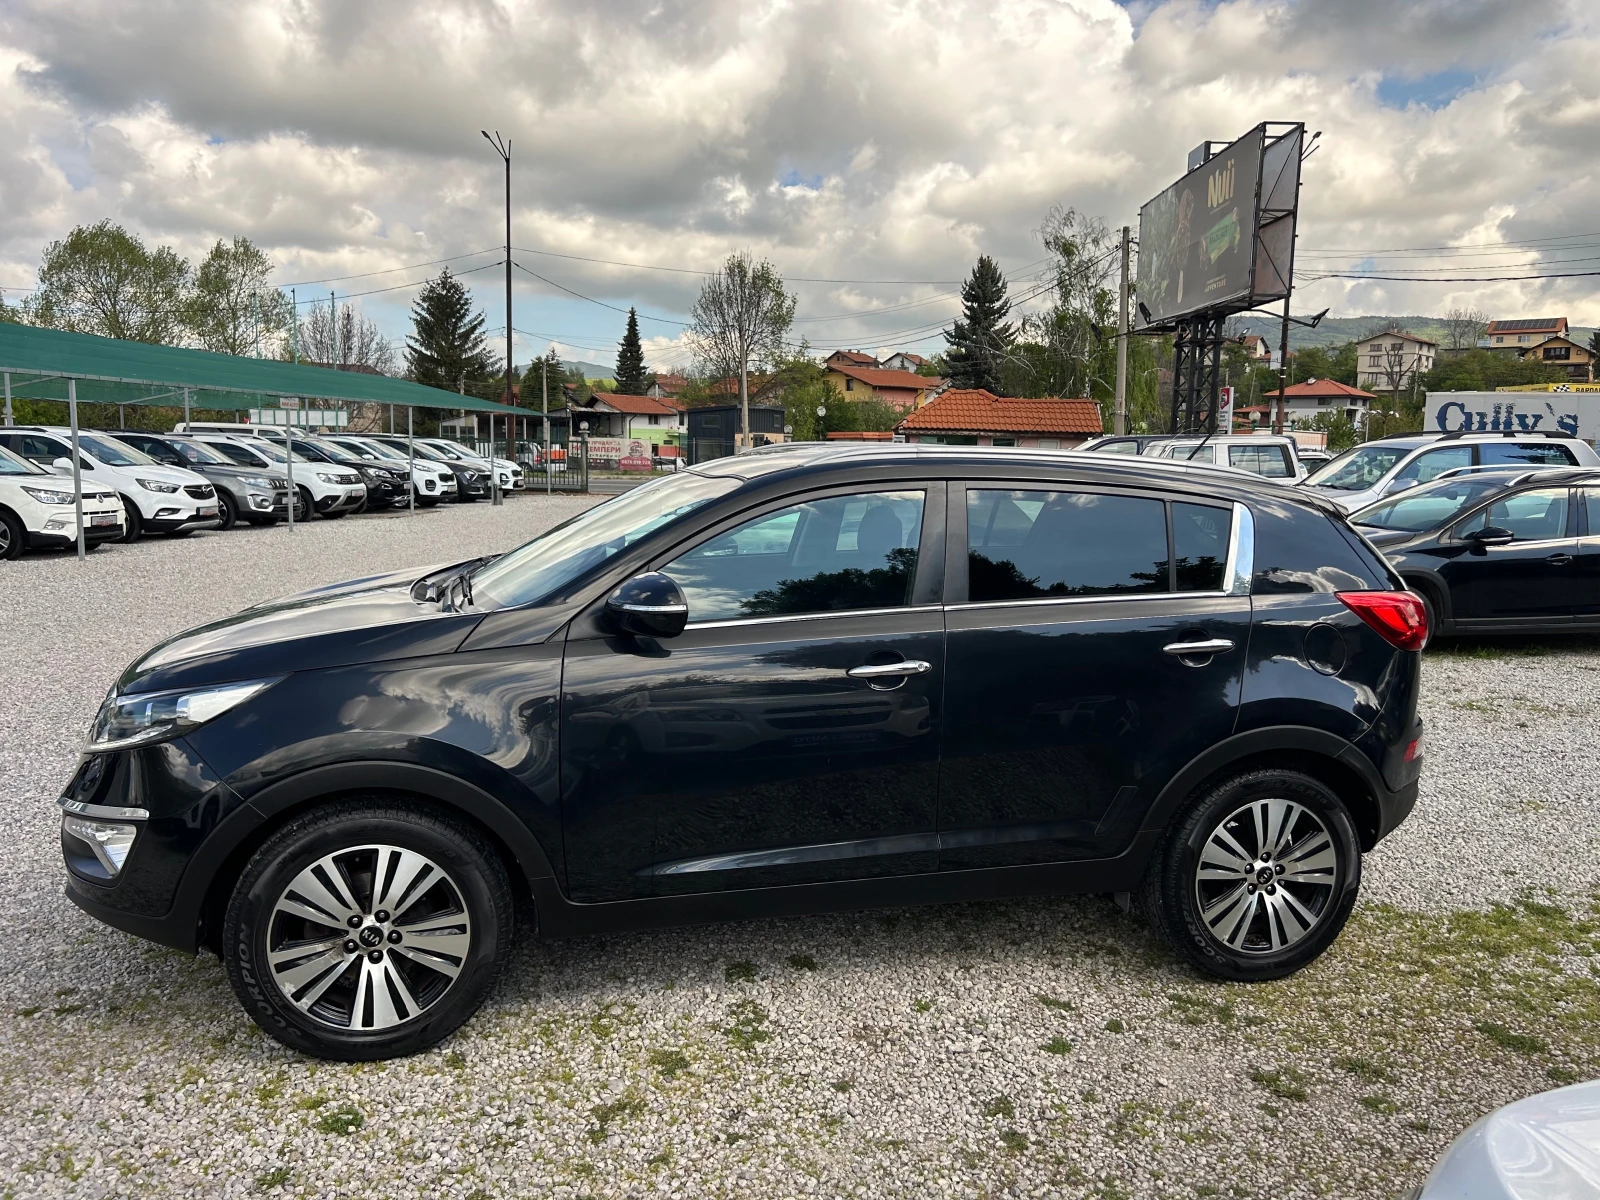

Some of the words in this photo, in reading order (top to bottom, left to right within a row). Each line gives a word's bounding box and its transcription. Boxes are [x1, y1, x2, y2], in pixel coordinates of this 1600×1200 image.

[1258, 870, 1272, 884] KIA
[362, 930, 380, 944] KIA
[238, 922, 302, 1038] SCORPION
